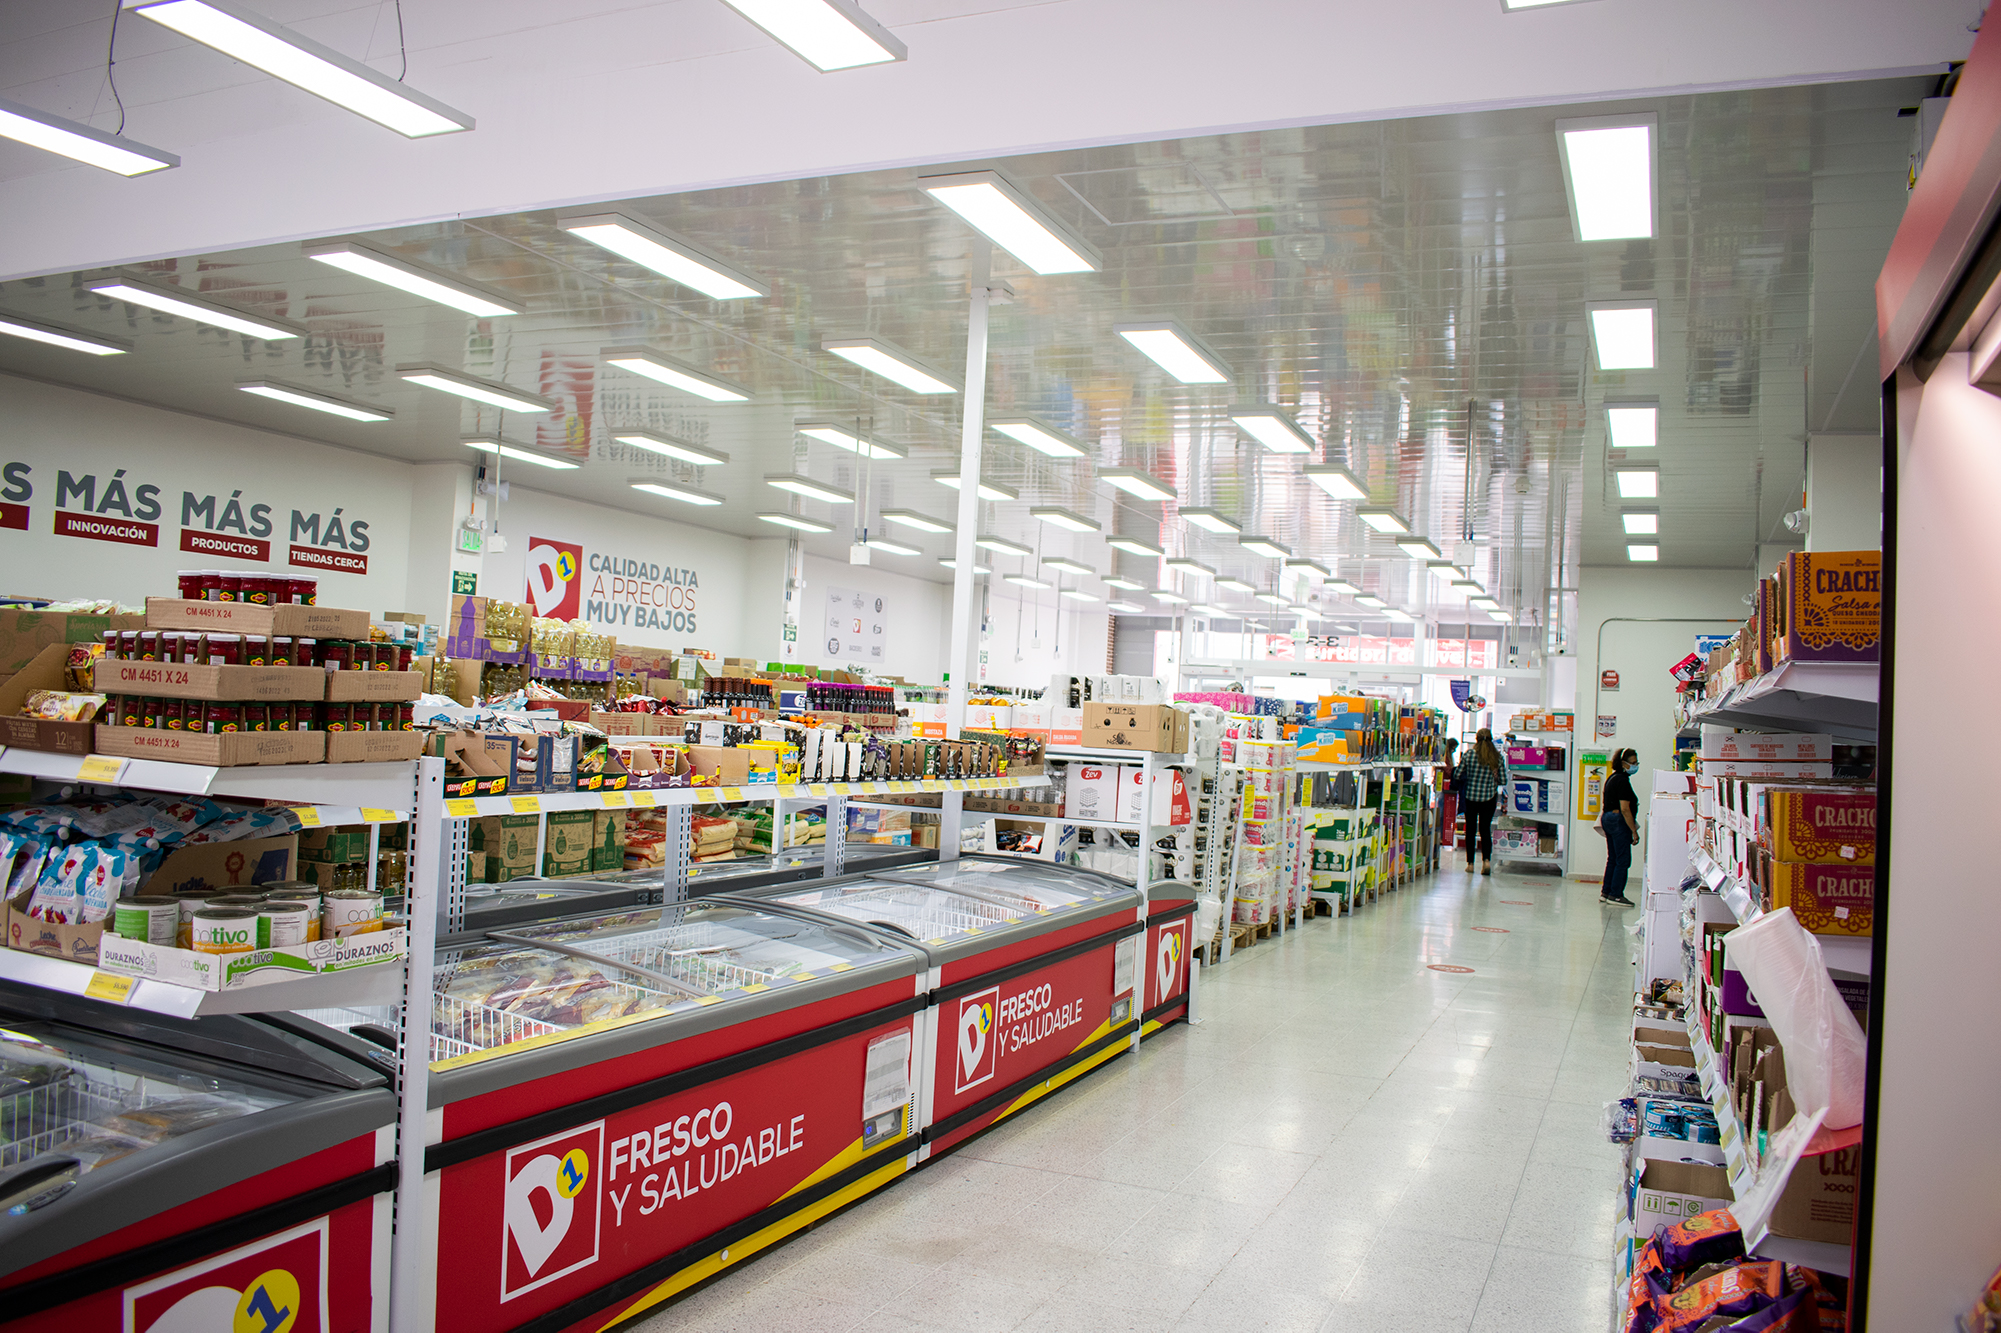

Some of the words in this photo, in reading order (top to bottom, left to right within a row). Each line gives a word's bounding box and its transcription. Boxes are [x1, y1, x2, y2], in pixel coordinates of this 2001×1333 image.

[56, 469, 161, 521] MÁS
[181, 490, 273, 538] MÁS
[67, 519, 147, 540] INNOVACIÓN
[290, 508, 370, 552] MÁS
[191, 537, 258, 556] PRODUCTOS
[291, 550, 333, 565] TIENDAS
[335, 557, 365, 569] CERCA
[589, 553, 660, 581] CALIDAD
[665, 566, 699, 588] ALTA
[1816, 568, 1881, 594] CRACH
[591, 574, 605, 599] A
[612, 577, 696, 611] PRECIOS
[1827, 595, 1871, 612] Salsa
[186, 606, 198, 615] CM
[199, 608, 215, 618] 4451
[216, 609, 222, 617] X
[223, 609, 232, 618] 24
[587, 599, 633, 627] MUY
[634, 606, 697, 633] BAJOS
[121, 668, 136, 681] CM
[139, 669, 162, 683] 4451
[165, 670, 173, 683] X
[176, 671, 189, 684] 24
[55, 731, 67, 746] 12
[134, 736, 145, 745] CM
[147, 737, 163, 747] 4451
[164, 738, 170, 747] X
[172, 739, 180, 748] 24
[105, 950, 144, 966] DURAZNOS
[336, 942, 394, 962] DURAZNOS
[999, 982, 1052, 1027] FRESCO
[999, 1031, 1009, 1057] Y
[1010, 998, 1084, 1052] SALUDABLE
[609, 1101, 733, 1182] FRESCO
[609, 1183, 632, 1227] Y
[639, 1114, 805, 1216] SALUDABLE
